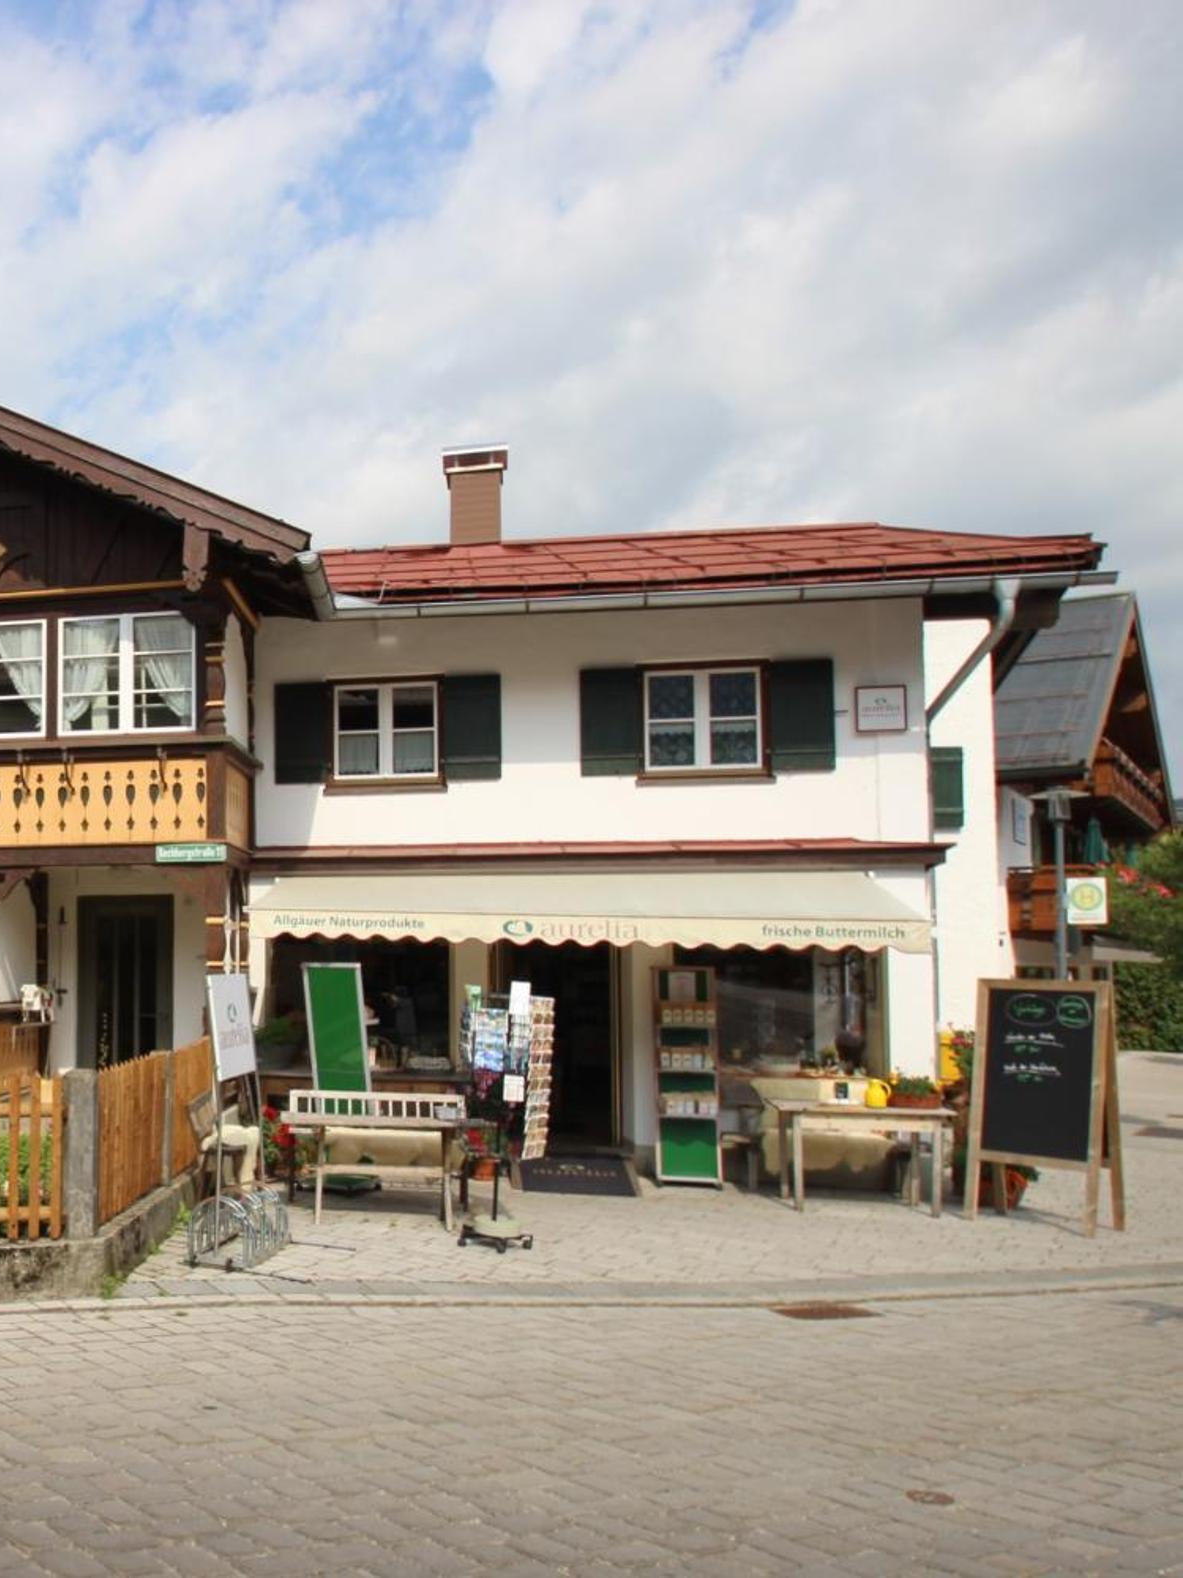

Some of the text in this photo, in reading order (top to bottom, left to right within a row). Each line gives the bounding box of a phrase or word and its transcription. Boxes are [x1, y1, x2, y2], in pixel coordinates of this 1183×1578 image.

[273, 914, 425, 929] Allgäuer Naturprodukte
[540, 918, 638, 938] aurelia
[762, 924, 905, 939] frische Buttermilch
